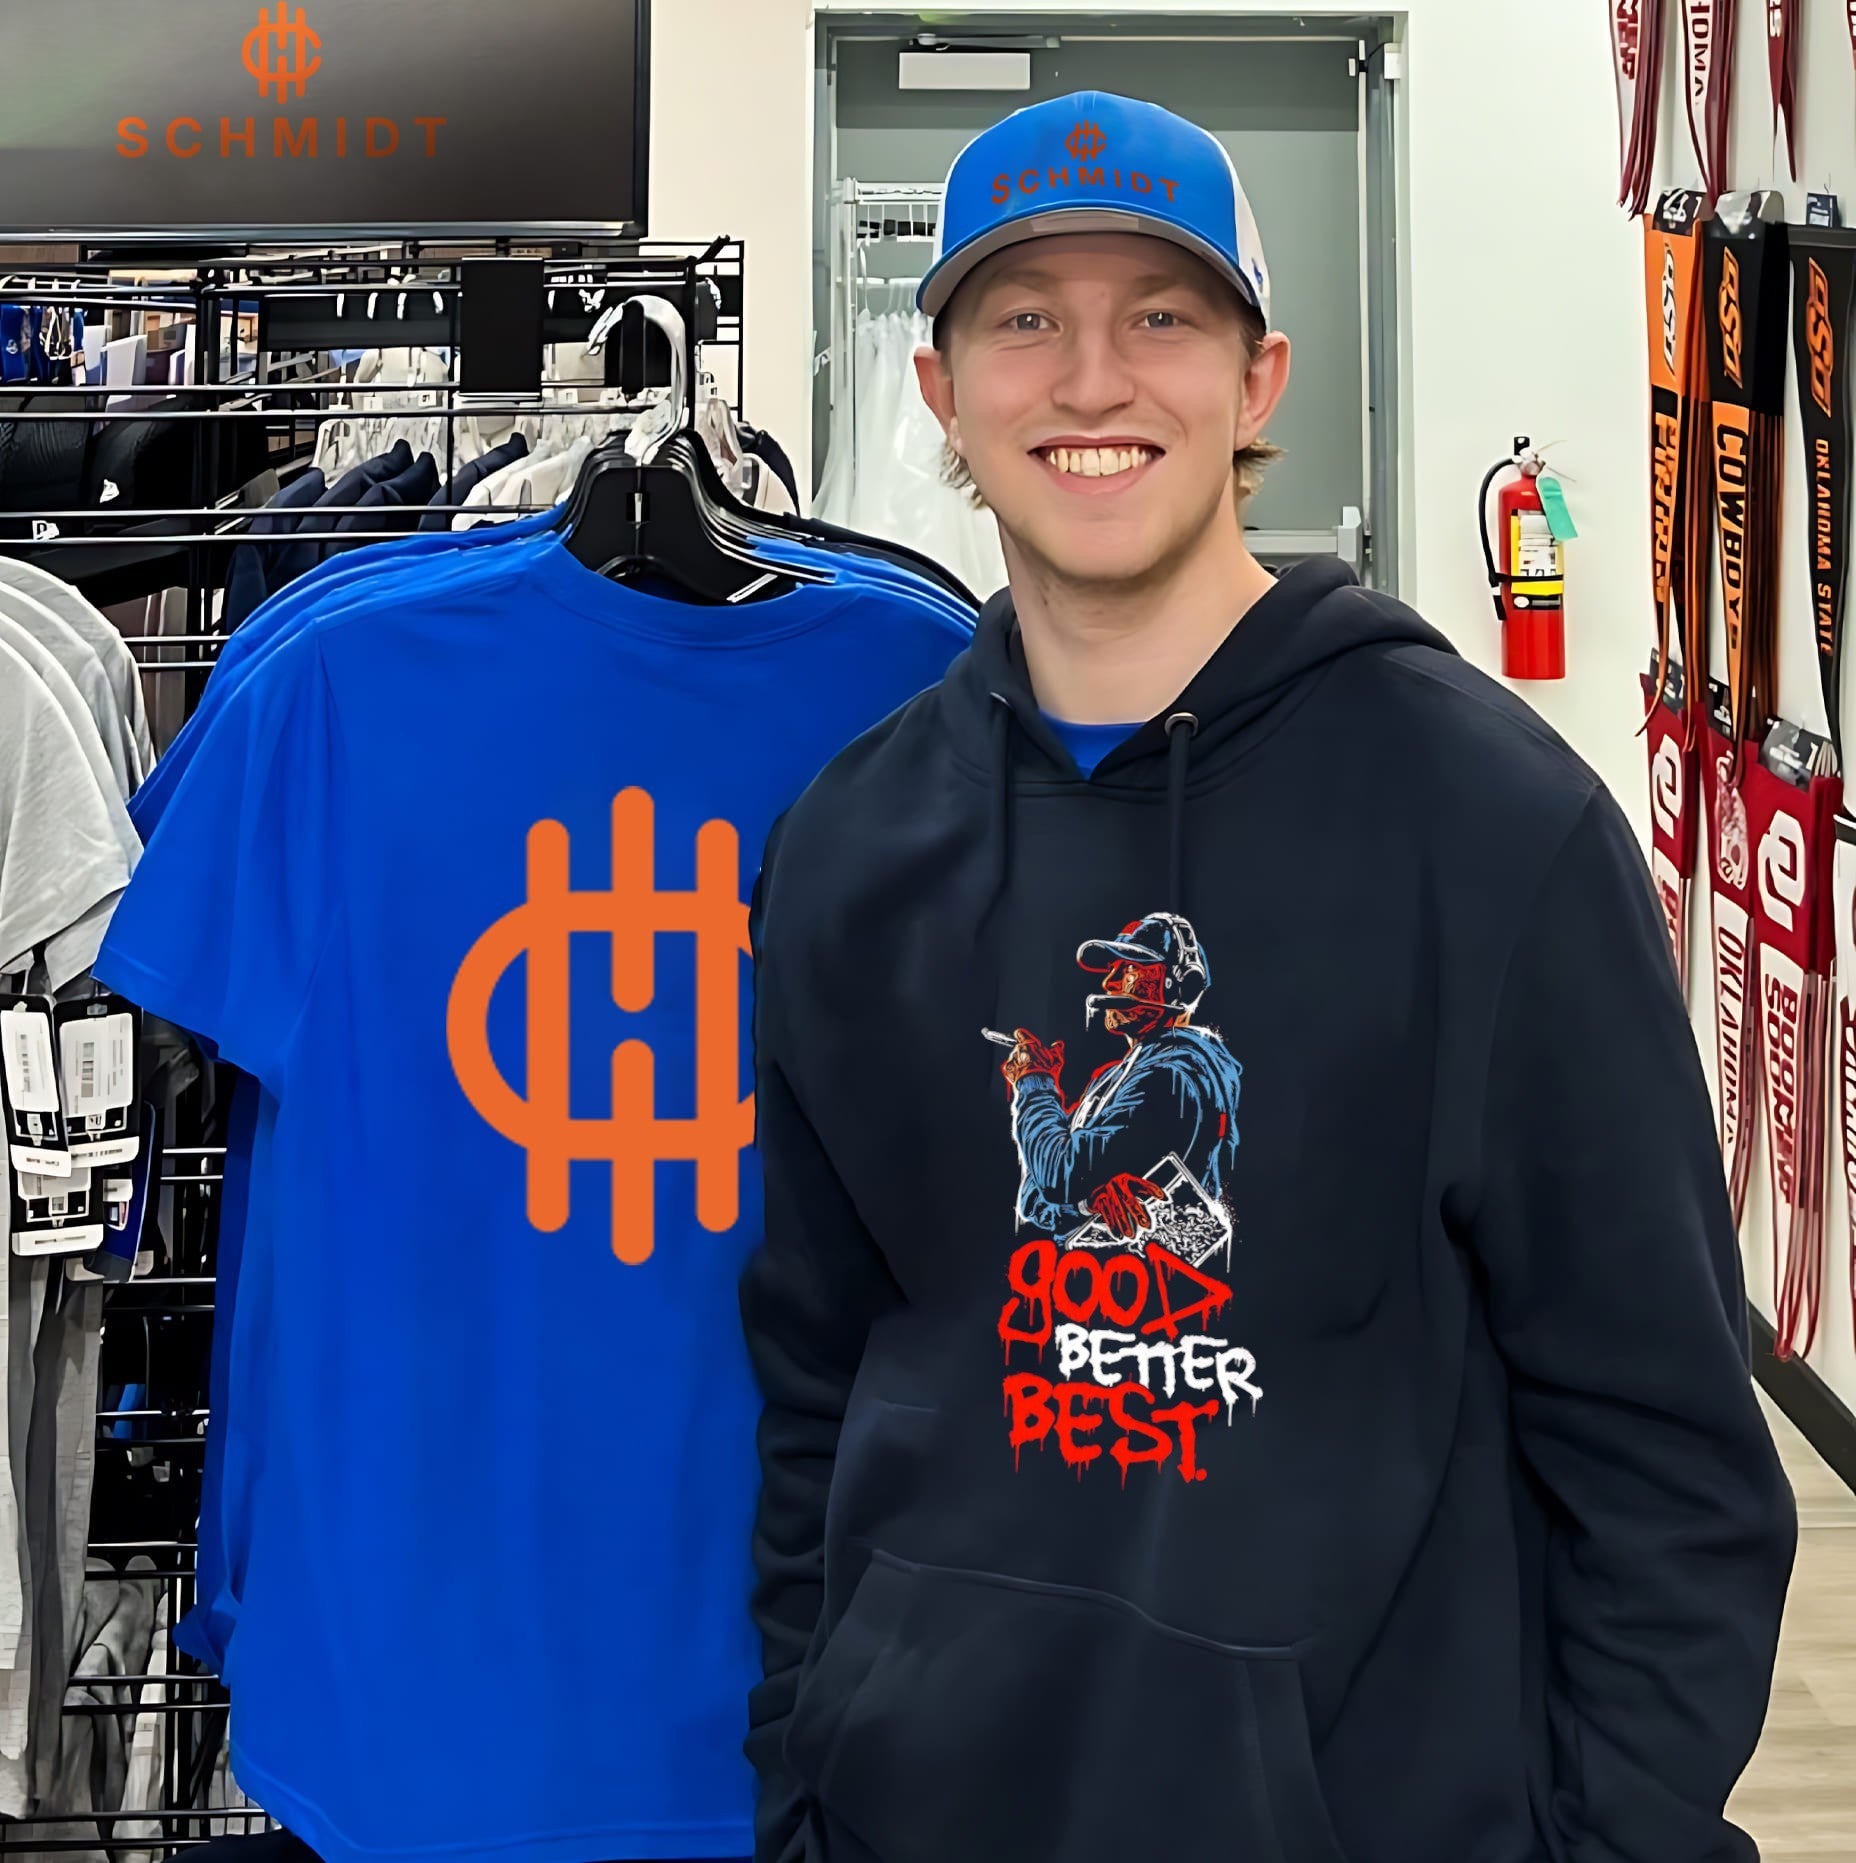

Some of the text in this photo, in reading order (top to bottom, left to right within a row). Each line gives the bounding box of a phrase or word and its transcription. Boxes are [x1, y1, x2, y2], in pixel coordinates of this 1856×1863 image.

[116, 116, 447, 158] SCHMIDT
[991, 167, 1179, 204] SCHMIDT
[1815, 438, 1832, 569] OKLAHOMA
[1718, 926, 1745, 1144] OKLAHOMA
[1055, 1323, 1263, 1412] BETTER
